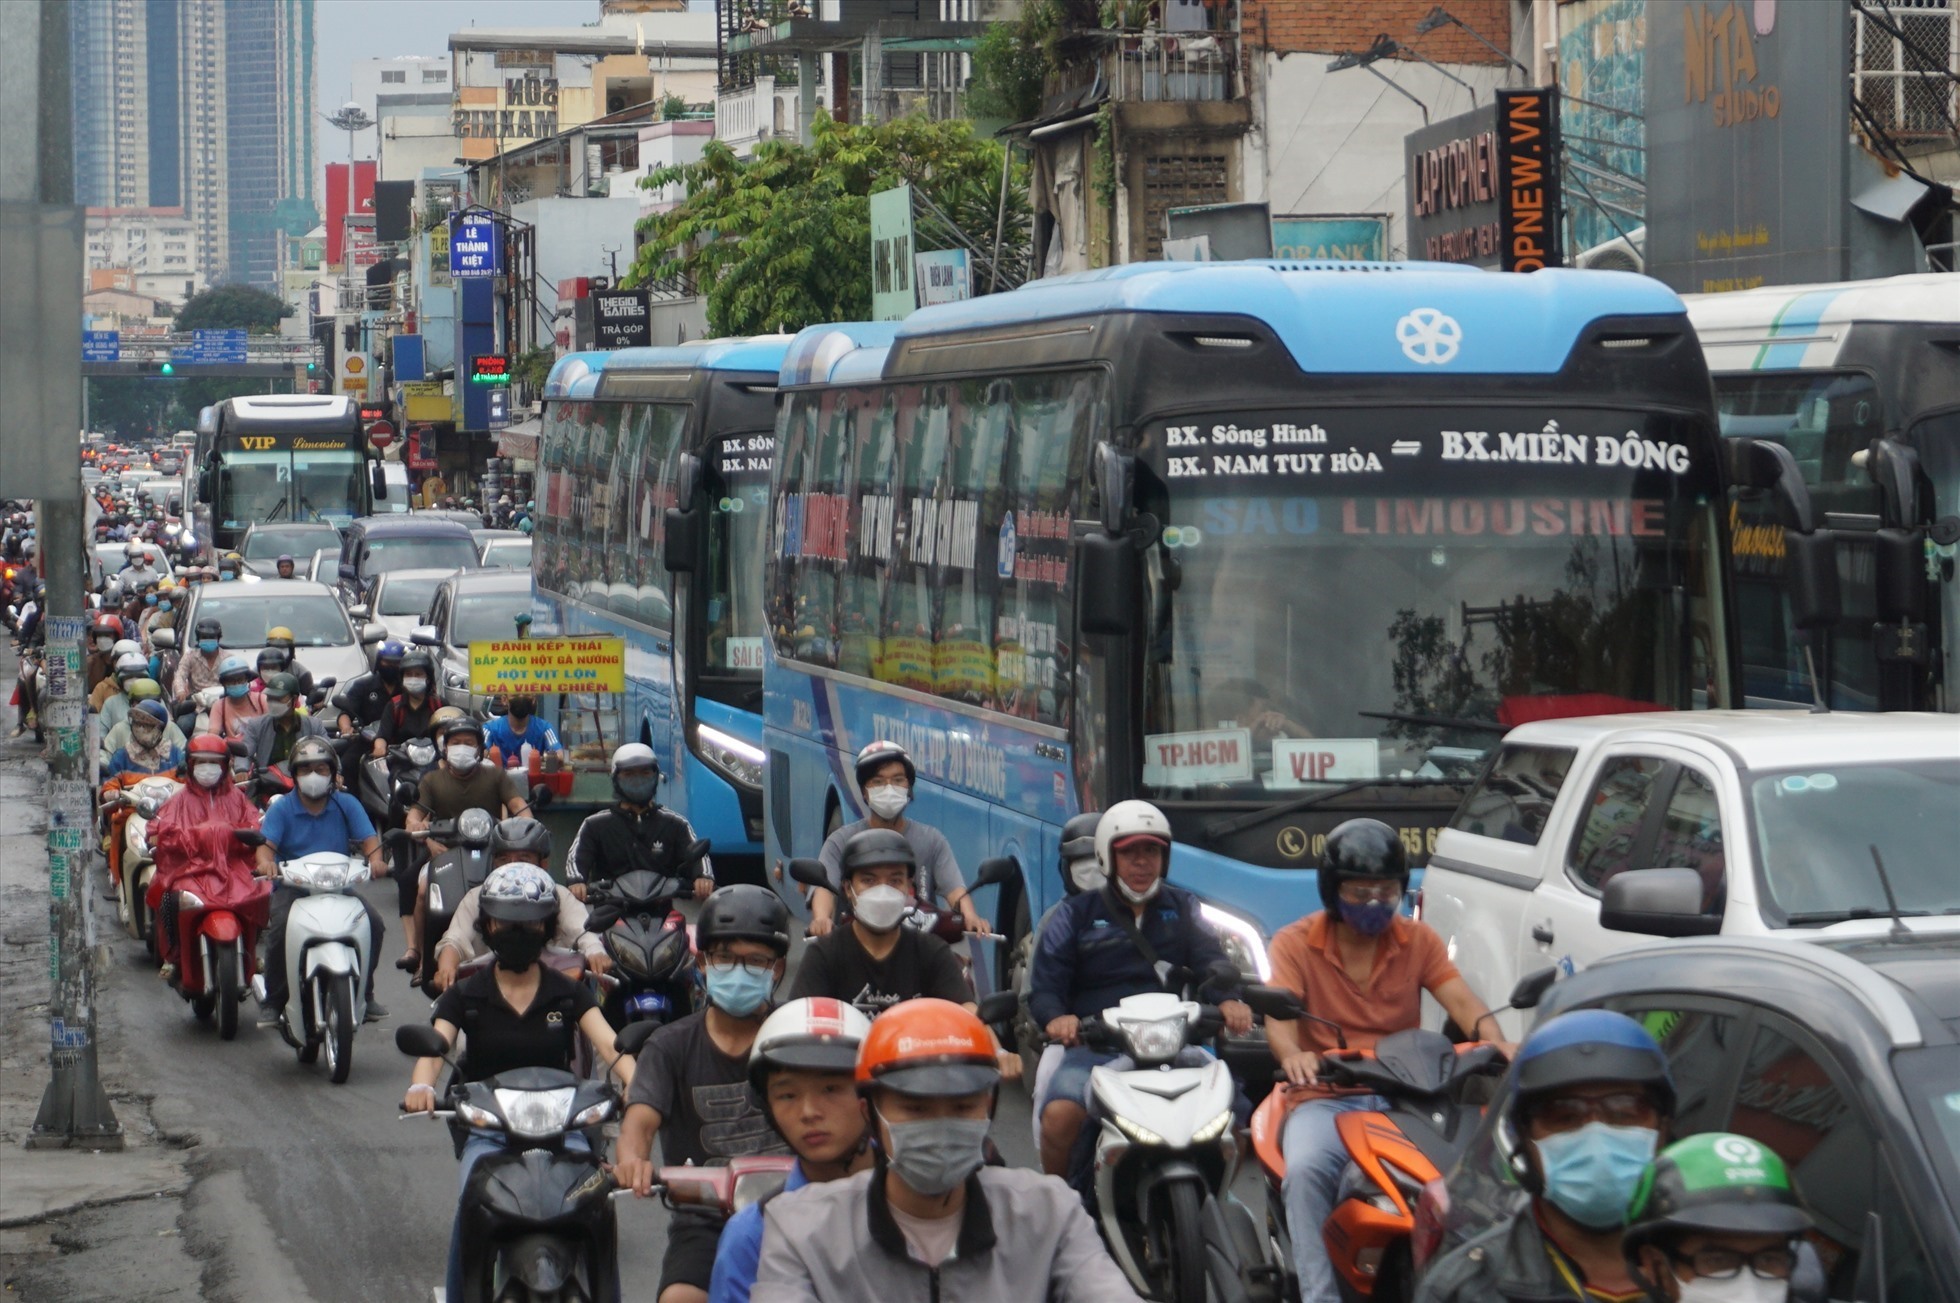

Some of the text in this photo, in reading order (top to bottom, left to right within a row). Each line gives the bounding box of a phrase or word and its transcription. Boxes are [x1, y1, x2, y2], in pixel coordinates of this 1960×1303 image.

[466, 227, 478, 238] LÊ
[456, 241, 488, 252] THÀNH
[462, 256, 483, 267] KIỆT
[604, 306, 645, 317] GAMES
[602, 323, 644, 334] TRẢ GÓP
[616, 336, 630, 345] 0%
[240, 436, 346, 450] VIP Limousine
[1166, 424, 1327, 448] BX. Sông Hinh
[722, 439, 745, 453] BX.
[1441, 419, 1692, 474] BX.MIỀN ĐÔNG
[722, 458, 745, 472] BX.
[1167, 447, 1383, 477] BX. NAM TUY HÒA
[1203, 496, 1665, 537] SAO LIMOUSINE
[531, 655, 553, 666] HỘT
[497, 668, 597, 681] HỘT VỊT LỘN
[1157, 738, 1239, 767] TP.HCM
[1290, 751, 1336, 780] VIP
